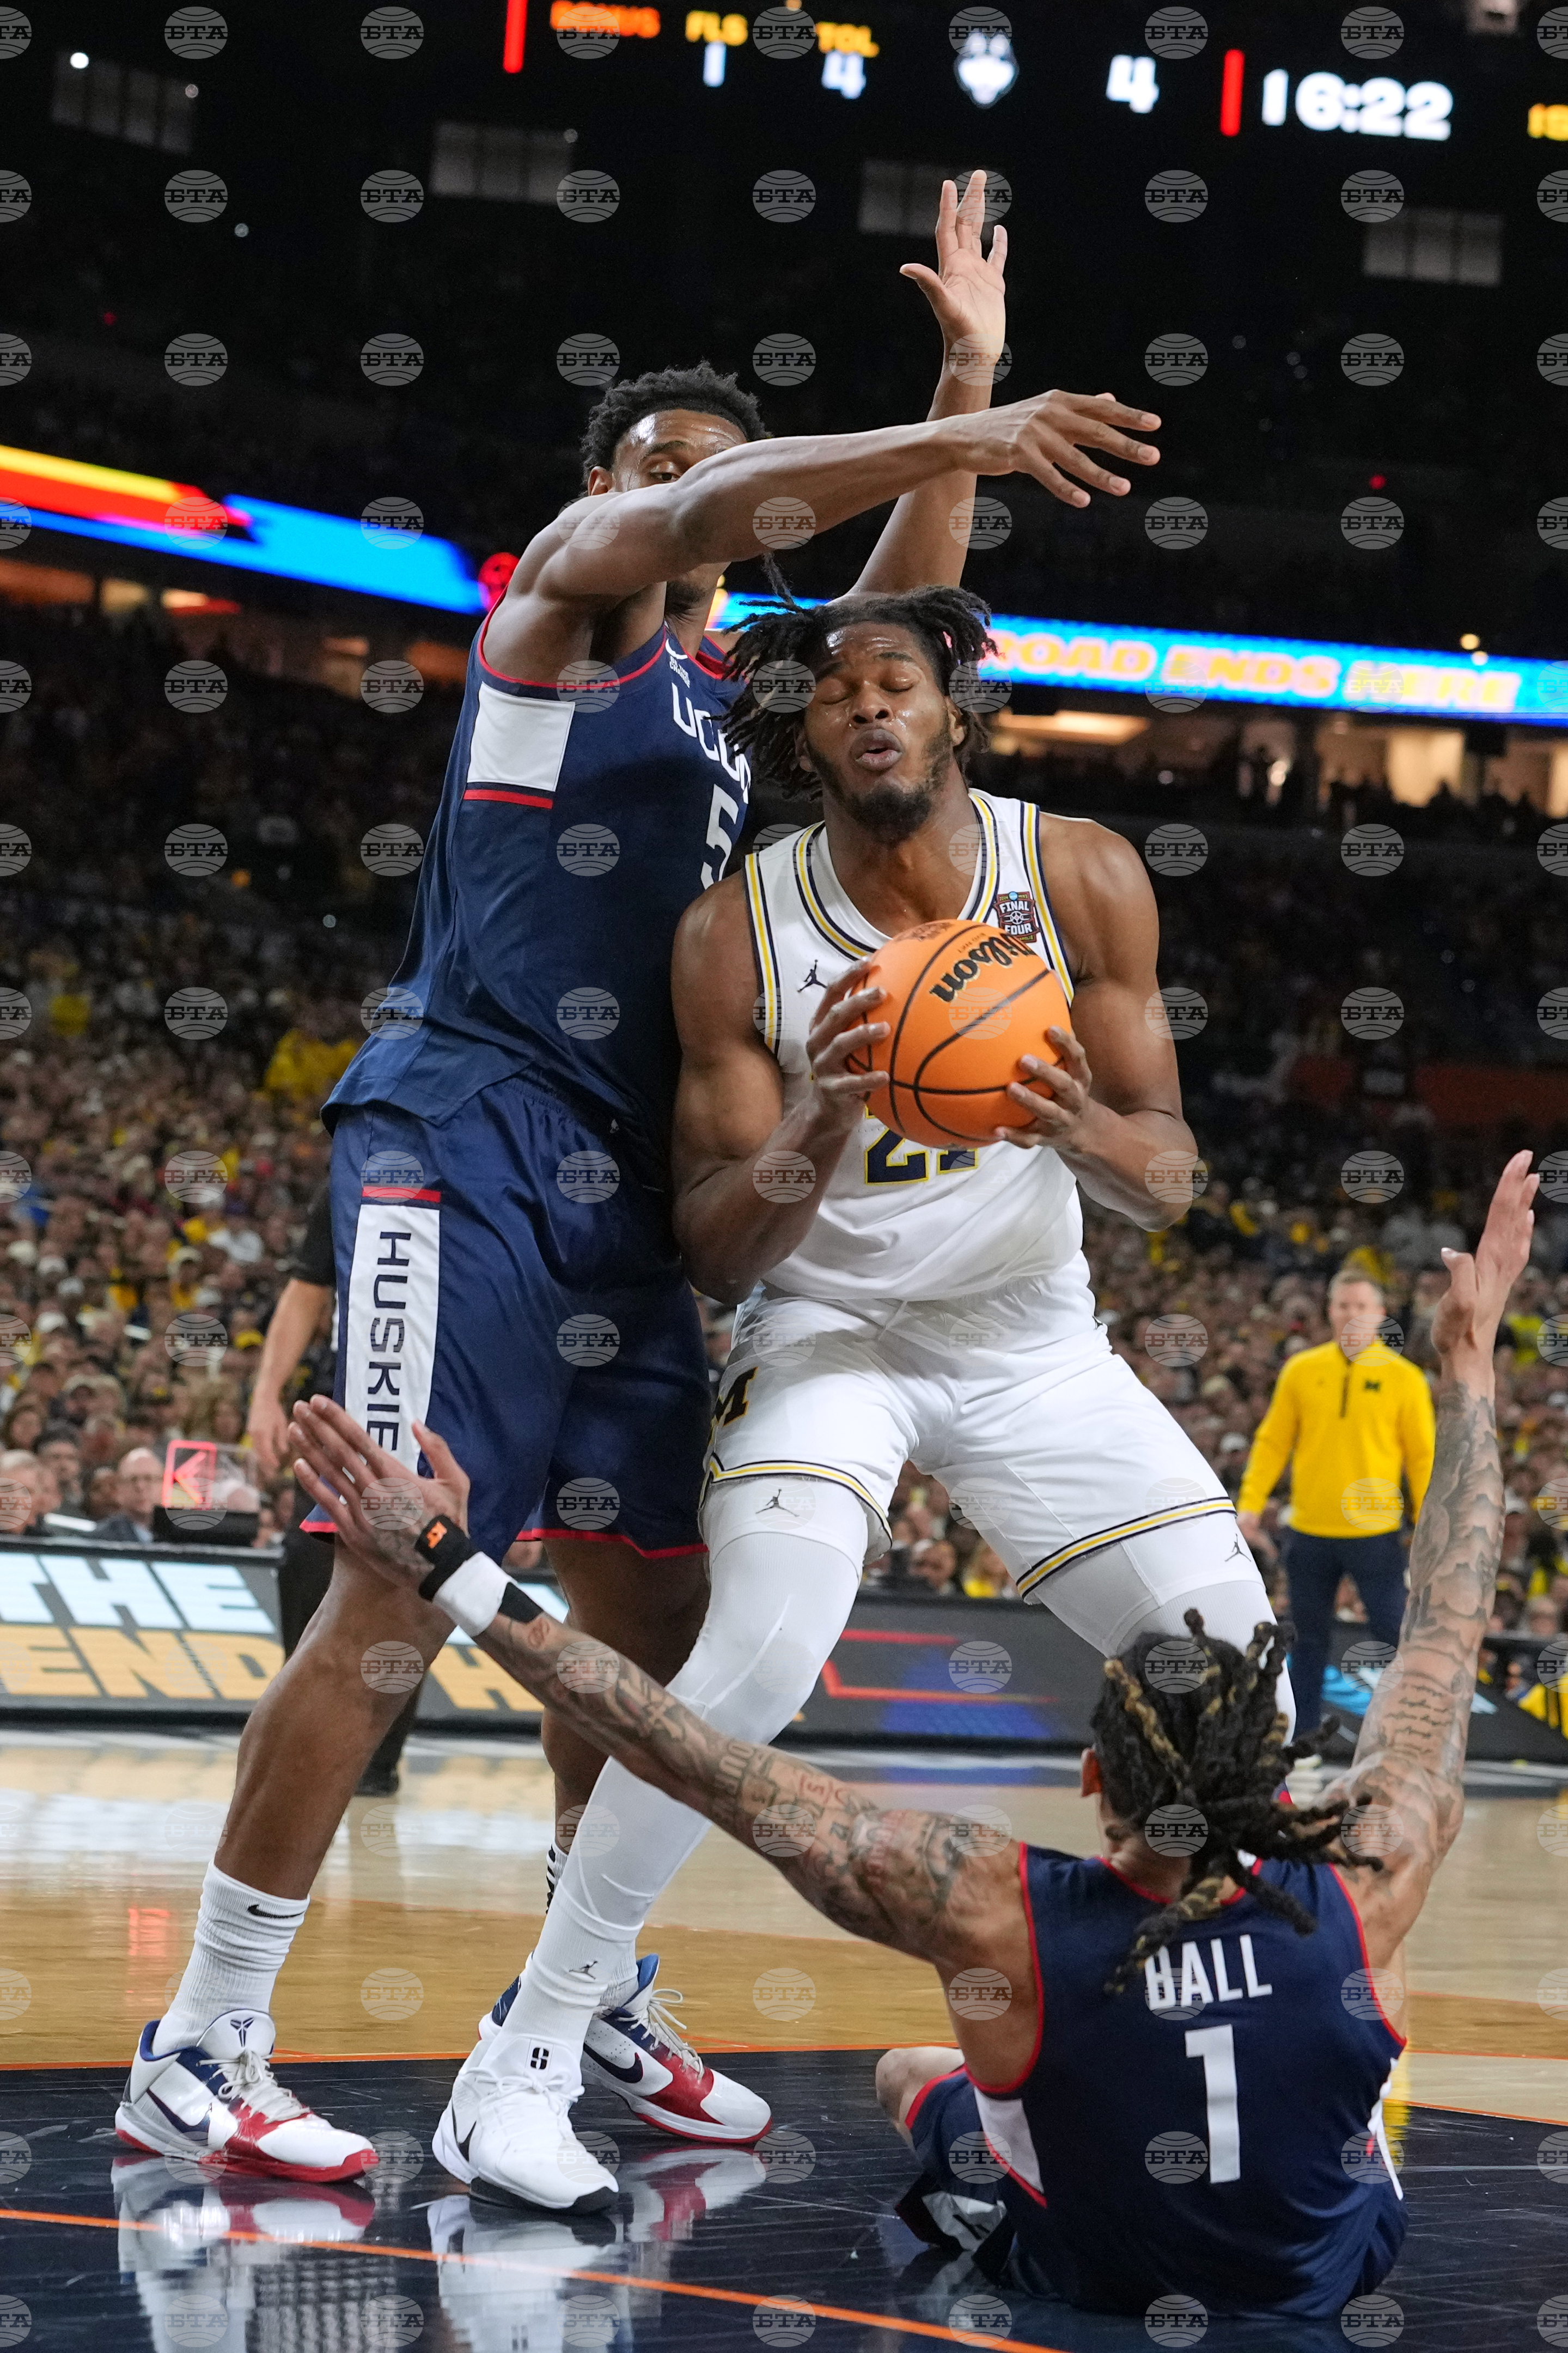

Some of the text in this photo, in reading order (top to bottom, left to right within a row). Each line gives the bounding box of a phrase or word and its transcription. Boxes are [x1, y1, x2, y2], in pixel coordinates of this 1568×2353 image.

[821, 51, 866, 99] 4
[1105, 53, 1160, 114] 4
[1261, 68, 1454, 141] 16:22
[669, 661, 690, 688] CHANGE
[1161, 645, 1341, 698] ENDS
[1346, 660, 1521, 713] HERE
[700, 783, 739, 890] 5
[999, 900, 1029, 914] FINAL
[1004, 923, 1033, 935] FOUR
[0, 1552, 276, 1633] THE
[1145, 1934, 1273, 2011] BALL
[1185, 2023, 1241, 2183] 1
